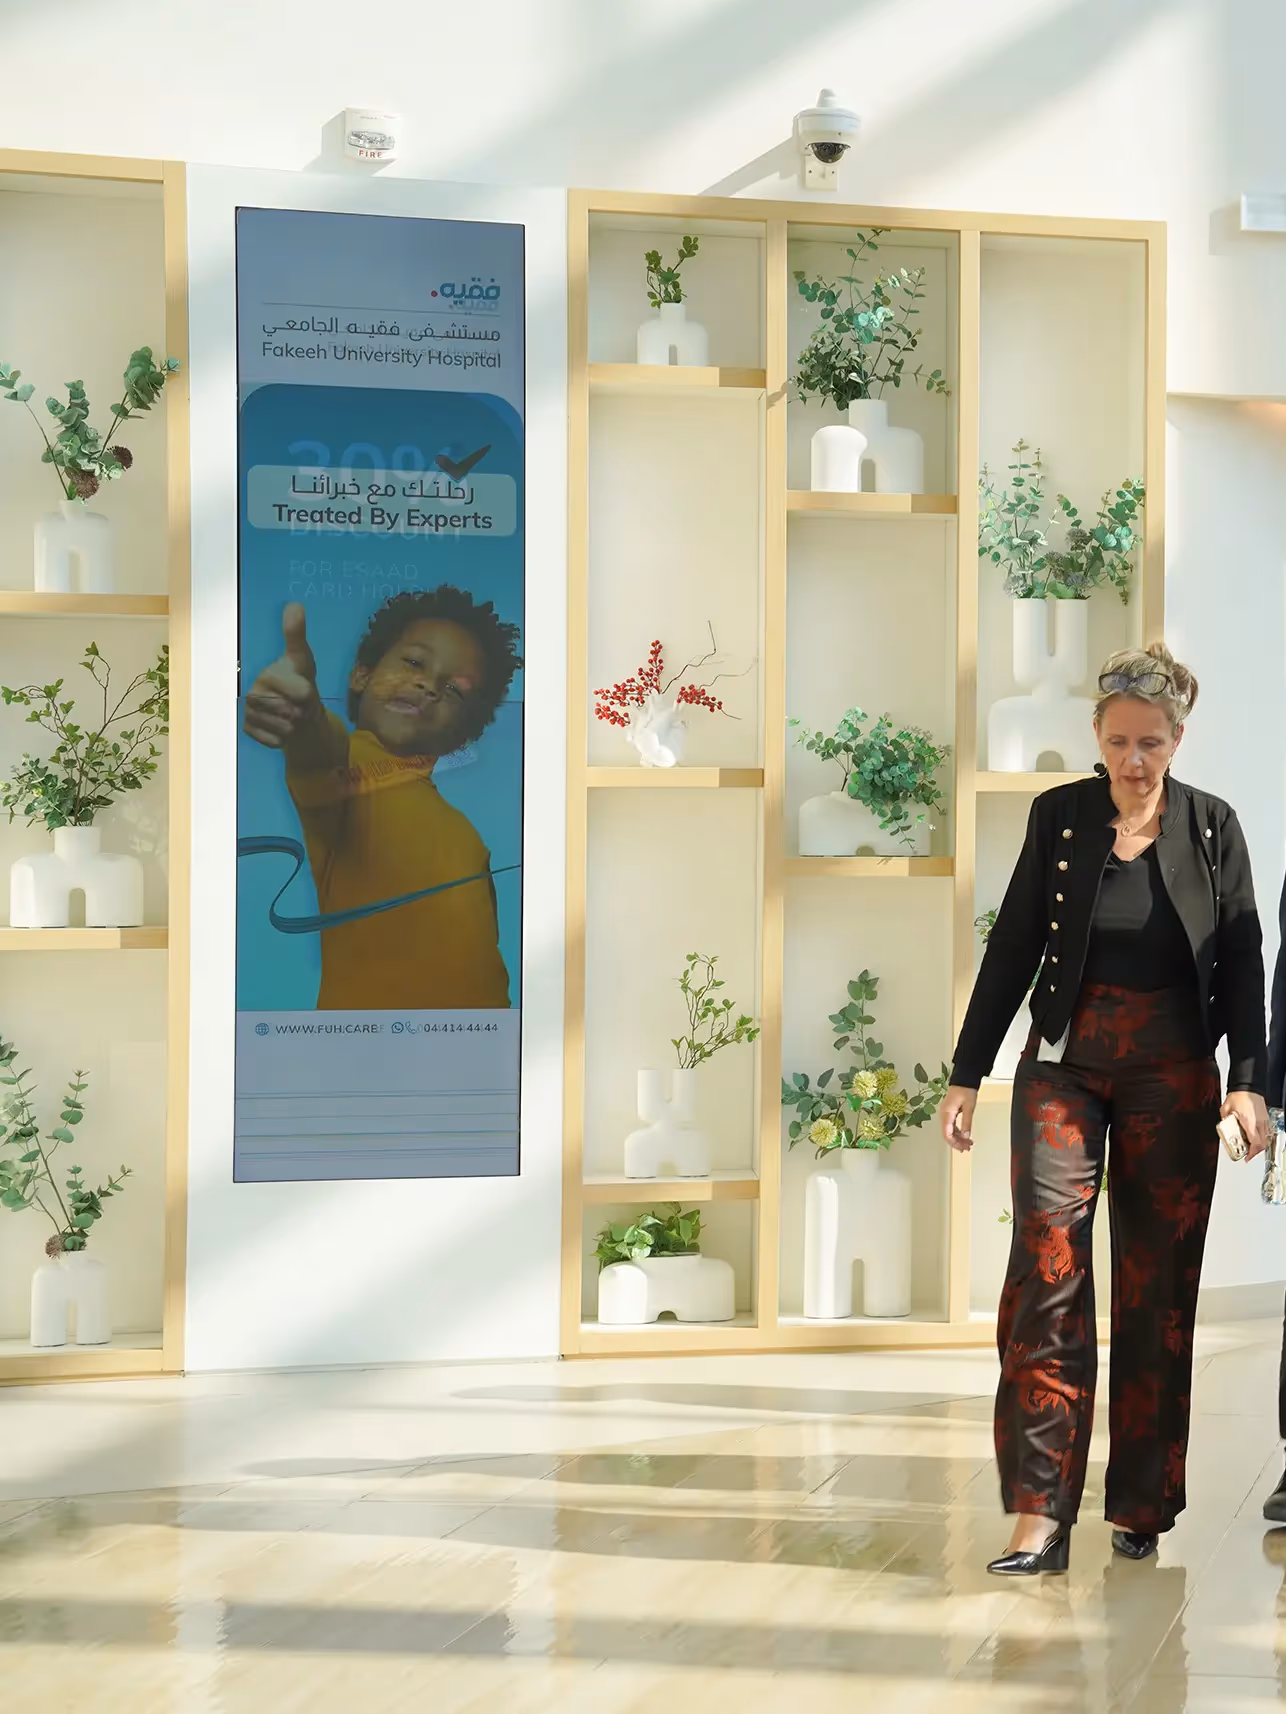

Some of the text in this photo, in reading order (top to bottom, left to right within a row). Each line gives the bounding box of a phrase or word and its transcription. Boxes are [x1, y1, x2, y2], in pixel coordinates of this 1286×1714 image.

[358, 149, 383, 159] FIRE
[262, 316, 339, 338] الجامعي
[347, 320, 401, 339] فقيه
[262, 341, 327, 360] Fakeeh
[333, 345, 423, 368] University
[427, 350, 501, 370] Hospital
[291, 474, 475, 505] رحلتك مع خبرائنا
[272, 503, 493, 532] Treated By Experts
